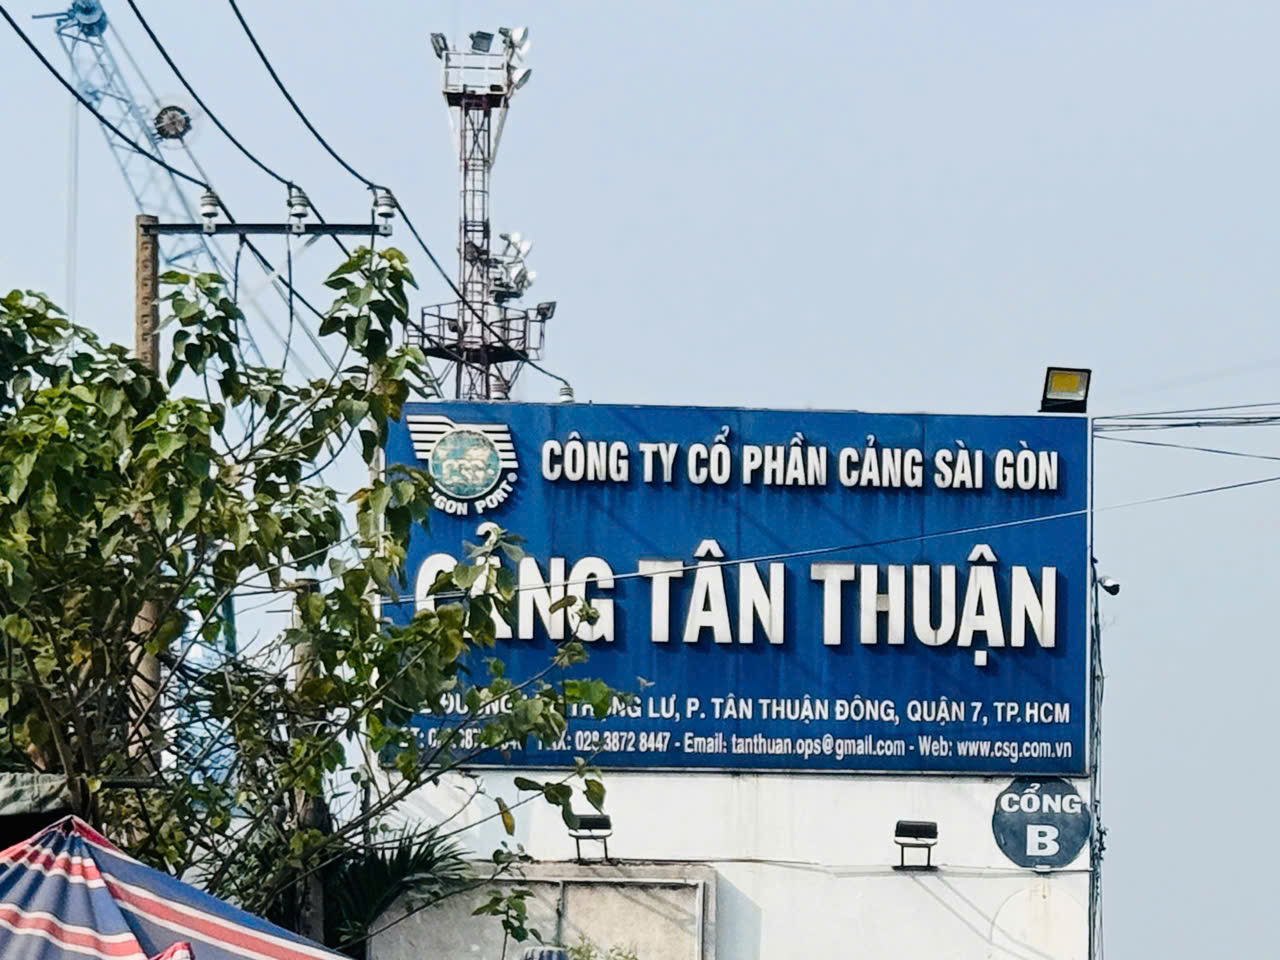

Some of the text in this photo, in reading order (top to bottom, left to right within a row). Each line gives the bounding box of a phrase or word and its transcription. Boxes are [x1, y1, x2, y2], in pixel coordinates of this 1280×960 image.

[542, 425, 1058, 490] CÔNG TY CỔ PHẦN CẢNG SÀI GÒN
[474, 480, 514, 514] PORT
[638, 539, 784, 644] TÂN
[811, 544, 1057, 666] THUẬN
[648, 694, 680, 722] LƯ,
[686, 697, 705, 719] P.
[711, 692, 752, 719] TÂN
[759, 694, 828, 724] THUẬN
[835, 694, 900, 725] ĐÔNG,
[906, 696, 965, 726] QUẬN
[971, 702, 988, 725] 7,
[639, 732, 670, 752] 8447
[684, 732, 728, 754] Email:
[732, 733, 905, 760] tanthuan.ops@gmail.com
[918, 736, 953, 757] Web:
[957, 741, 1073, 763] www.csg.com.vn
[1000, 783, 1082, 813] CỔNG
[1026, 824, 1060, 856] B
